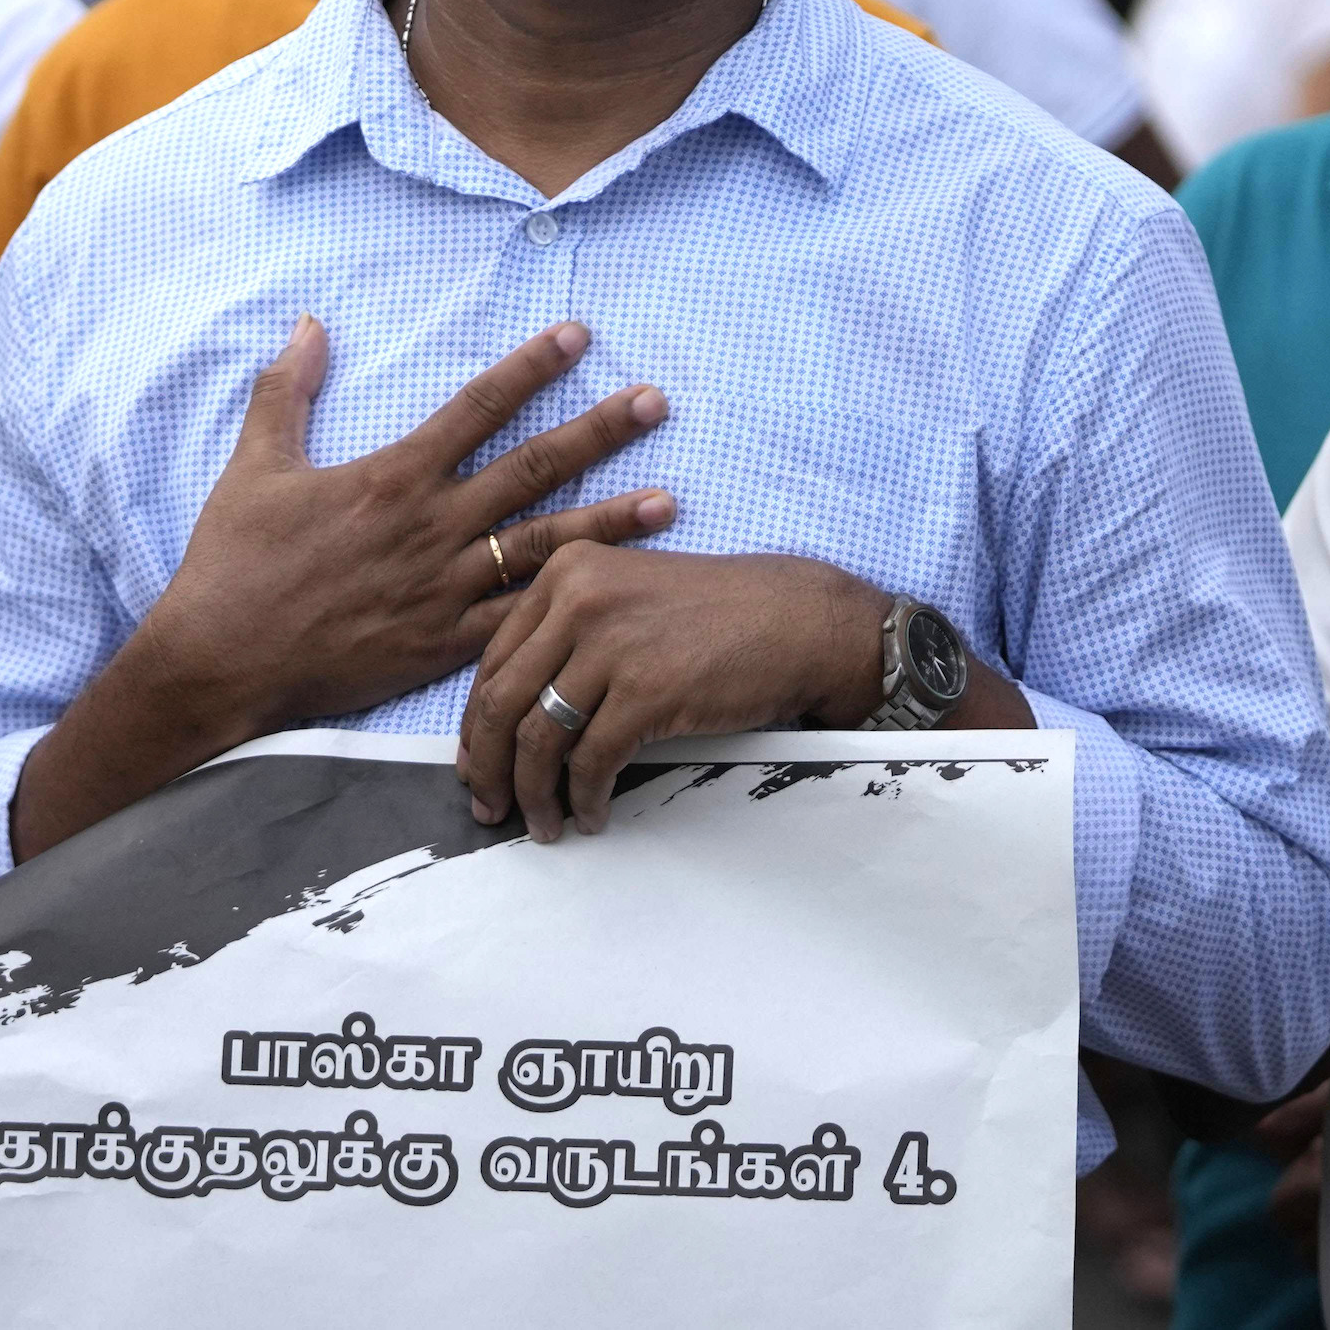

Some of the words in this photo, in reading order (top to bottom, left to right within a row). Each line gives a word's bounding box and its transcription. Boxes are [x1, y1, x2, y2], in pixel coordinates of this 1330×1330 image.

[222, 1011, 482, 1091] பாஸ்கா
[498, 1027, 734, 1115] ஞாயிறு
[481, 1119, 861, 1208] வருடங்கள்
[884, 1131, 957, 1205] 4.
